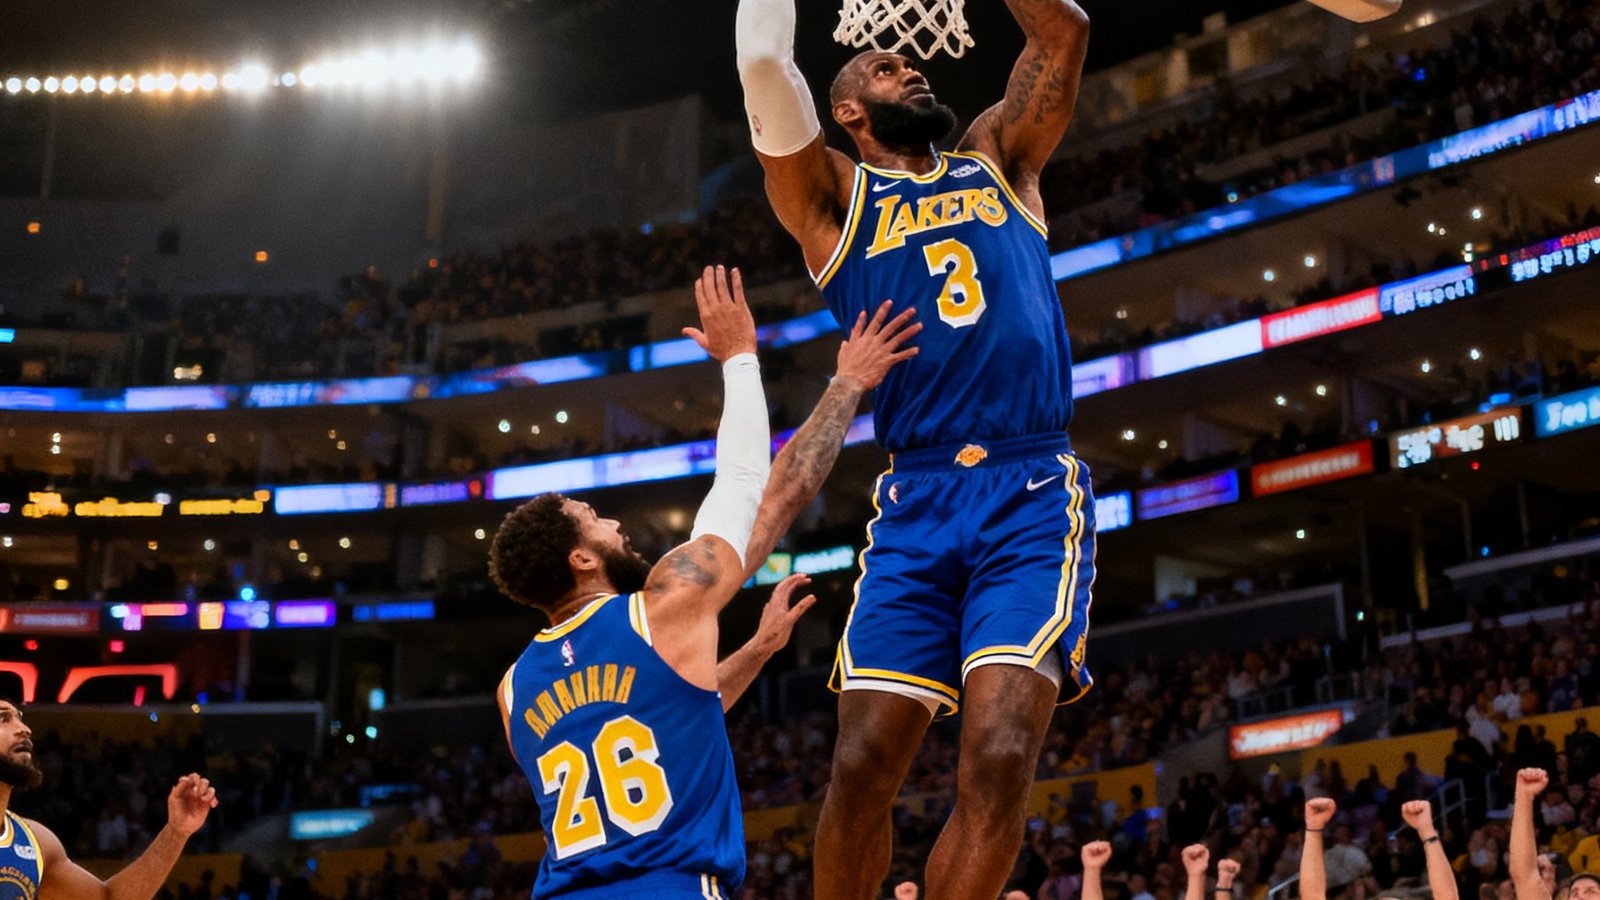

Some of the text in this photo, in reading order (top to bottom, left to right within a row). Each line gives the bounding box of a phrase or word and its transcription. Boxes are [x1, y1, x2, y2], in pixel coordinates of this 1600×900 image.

[866, 187, 1008, 259] LAKERS
[923, 238, 987, 328] 3
[536, 714, 674, 860] 26
